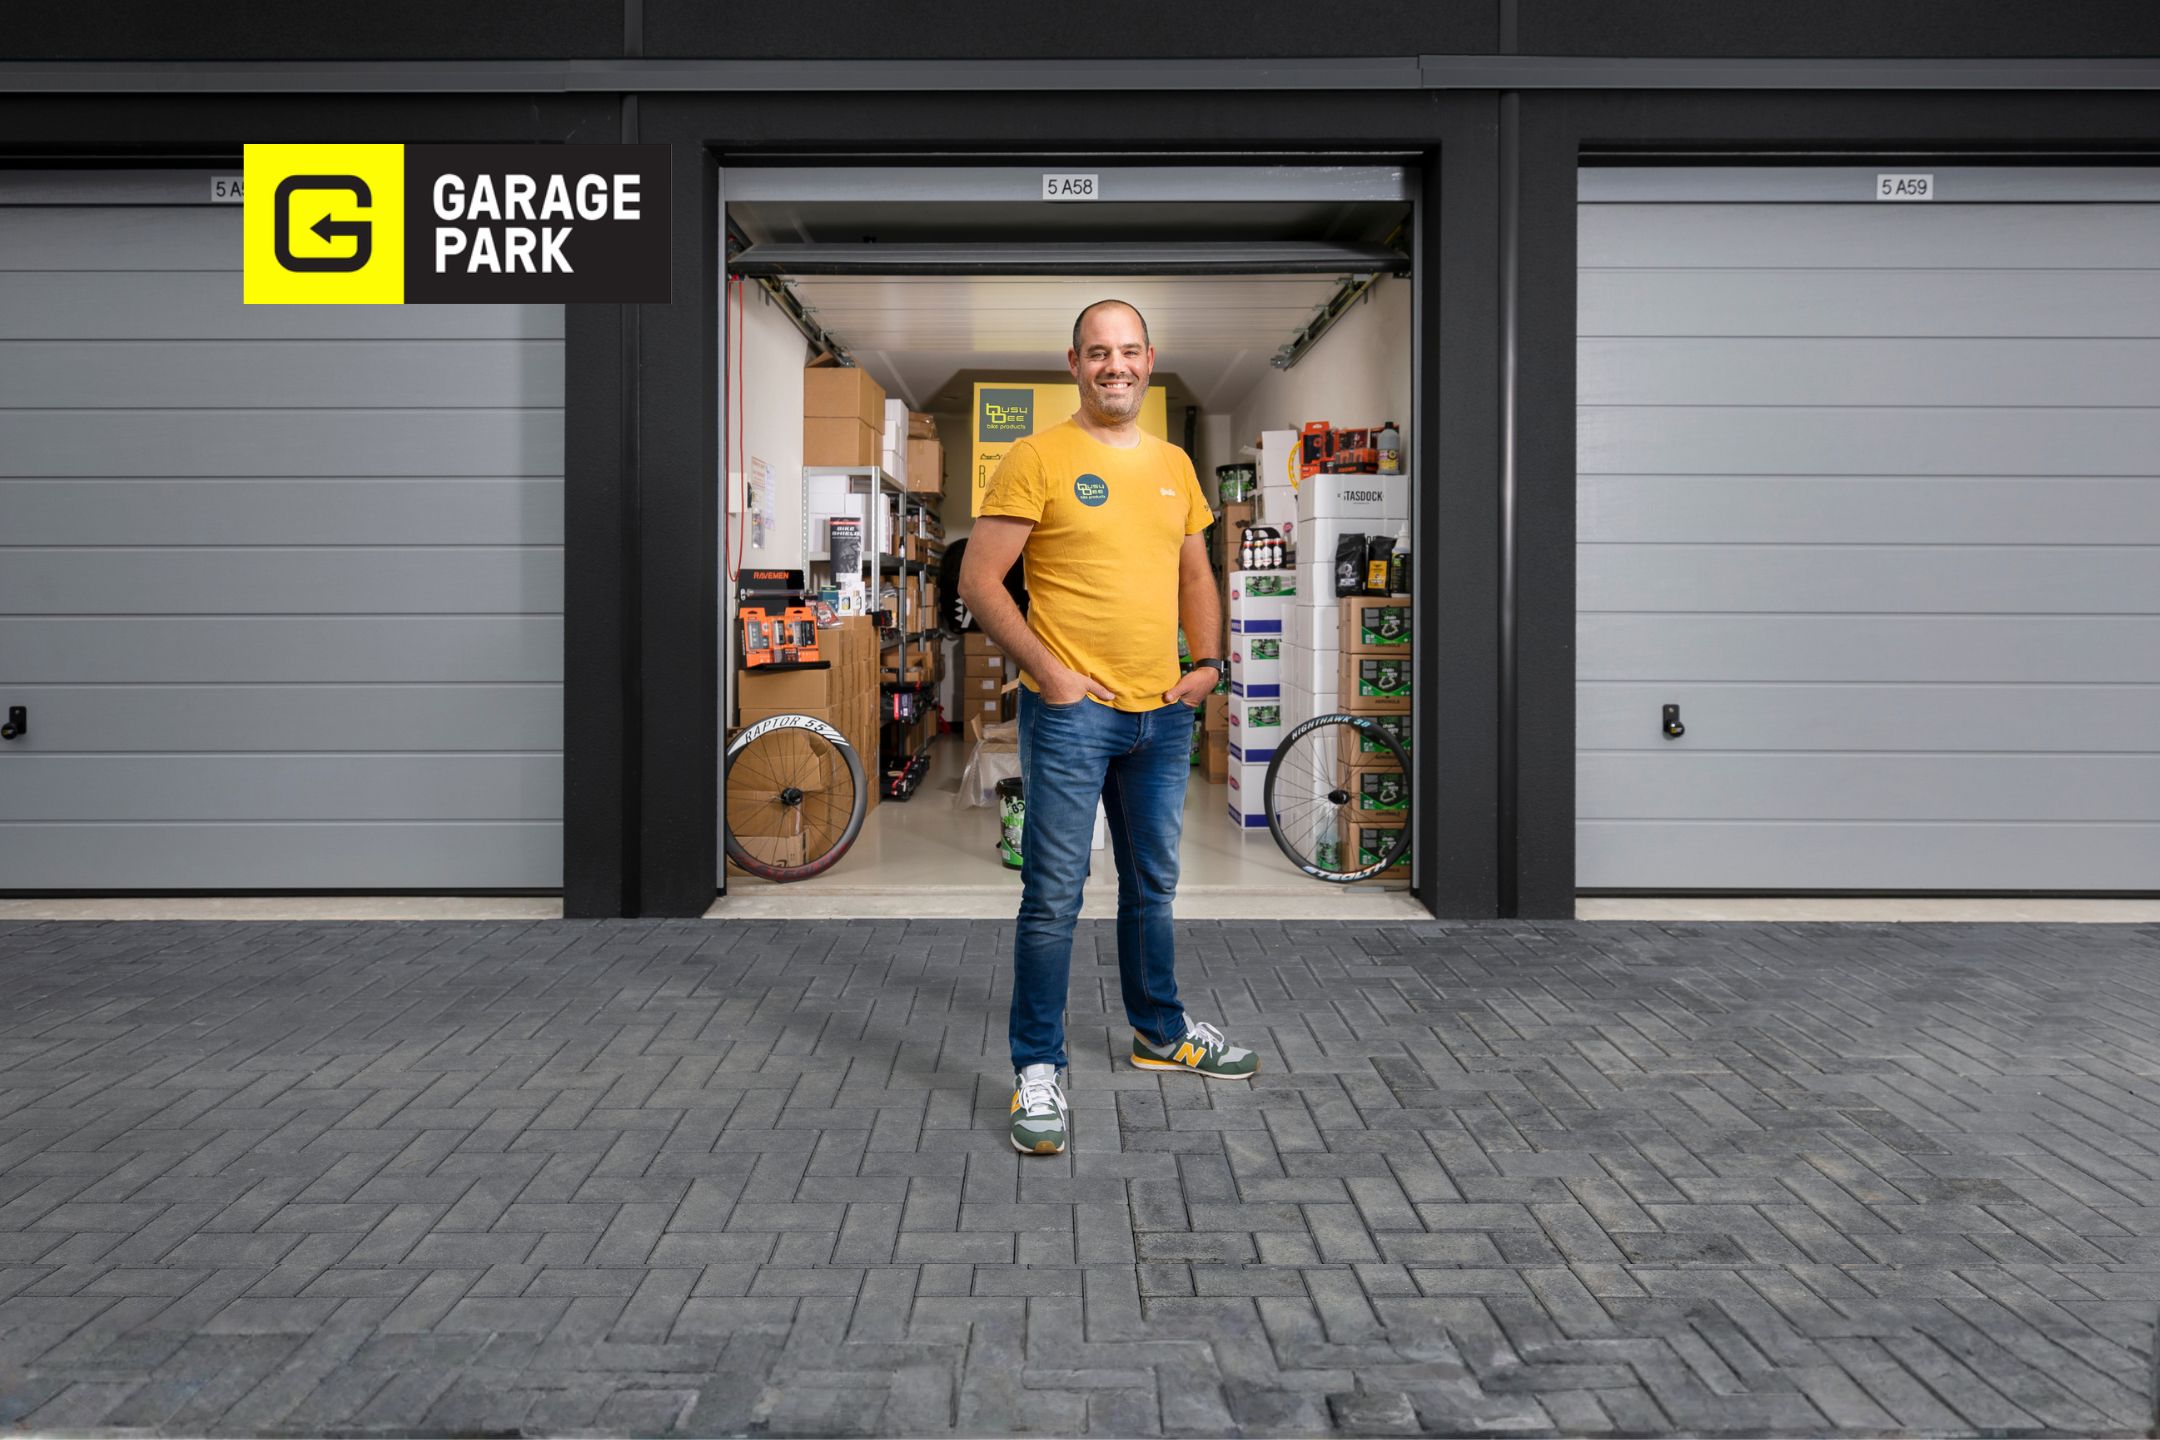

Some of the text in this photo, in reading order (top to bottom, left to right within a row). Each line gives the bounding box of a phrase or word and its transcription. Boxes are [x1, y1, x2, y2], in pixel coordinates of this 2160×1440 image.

[216, 181, 244, 197] 5 A
[1048, 179, 1093, 195] 5 A58
[1882, 179, 1927, 195] 5 A59
[753, 571, 790, 580] RAVEMEN
[744, 716, 828, 744] RAPTOR 55
[1291, 715, 1372, 741] NIGHTHAWK 30
[1173, 1041, 1208, 1068] N
